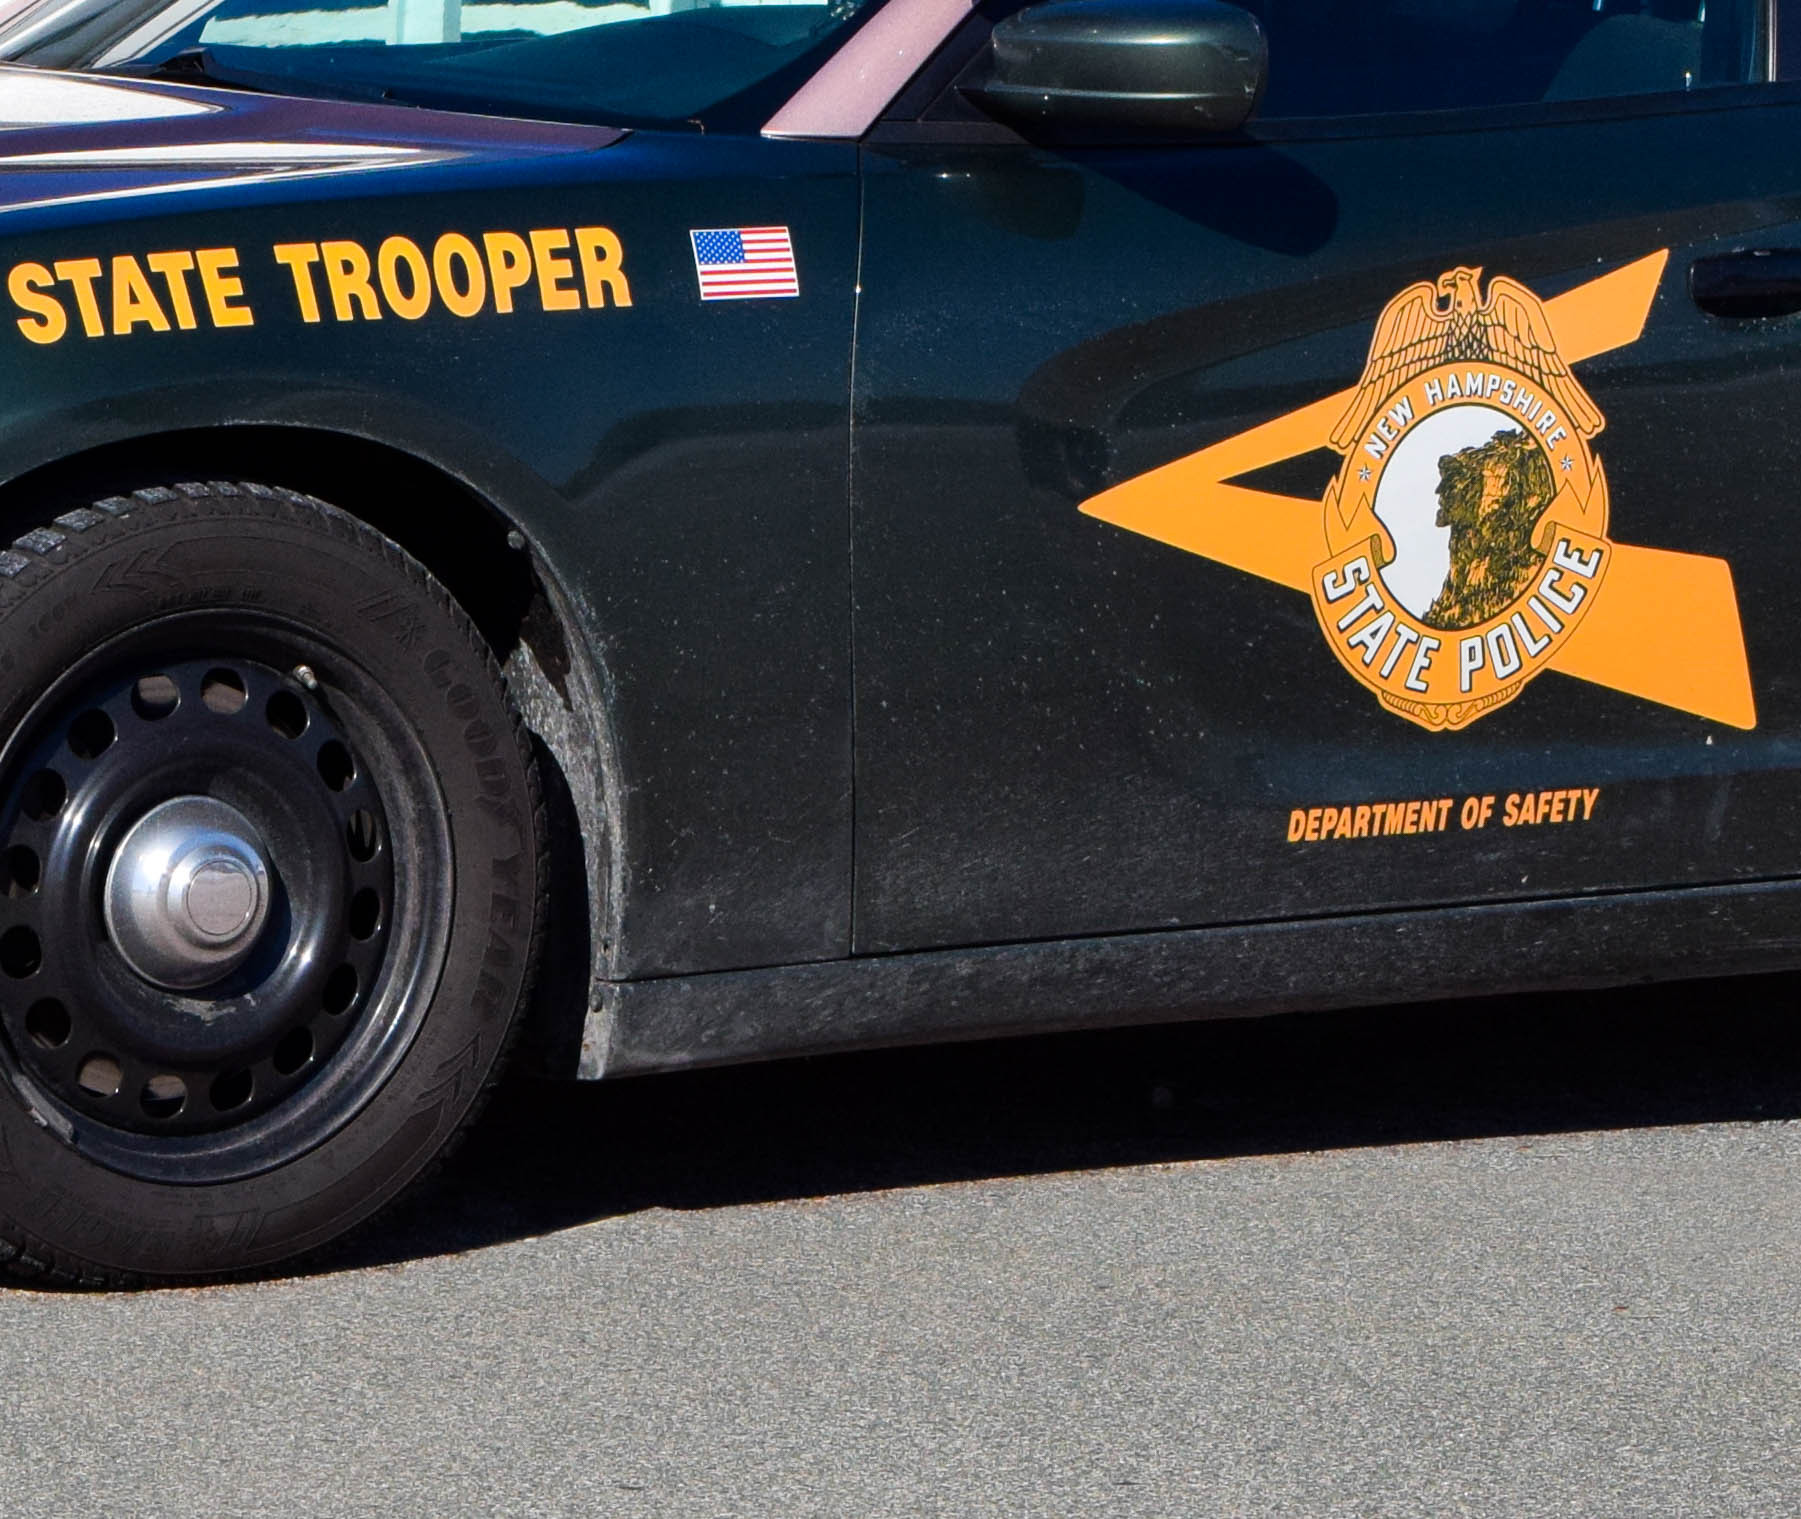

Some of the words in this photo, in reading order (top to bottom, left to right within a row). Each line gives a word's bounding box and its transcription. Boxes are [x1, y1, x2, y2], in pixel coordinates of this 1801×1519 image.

[8, 248, 253, 344] STATE
[274, 227, 632, 322] TROOPER
[1363, 396, 1414, 460] NEW
[1423, 371, 1568, 451] HAMPSHIRE
[1322, 556, 1441, 693] STATE
[1459, 540, 1603, 694] POLICE
[1287, 799, 1454, 842] DEPARTMENT
[1460, 793, 1496, 830] OF
[1504, 787, 1600, 826] SAFETY
